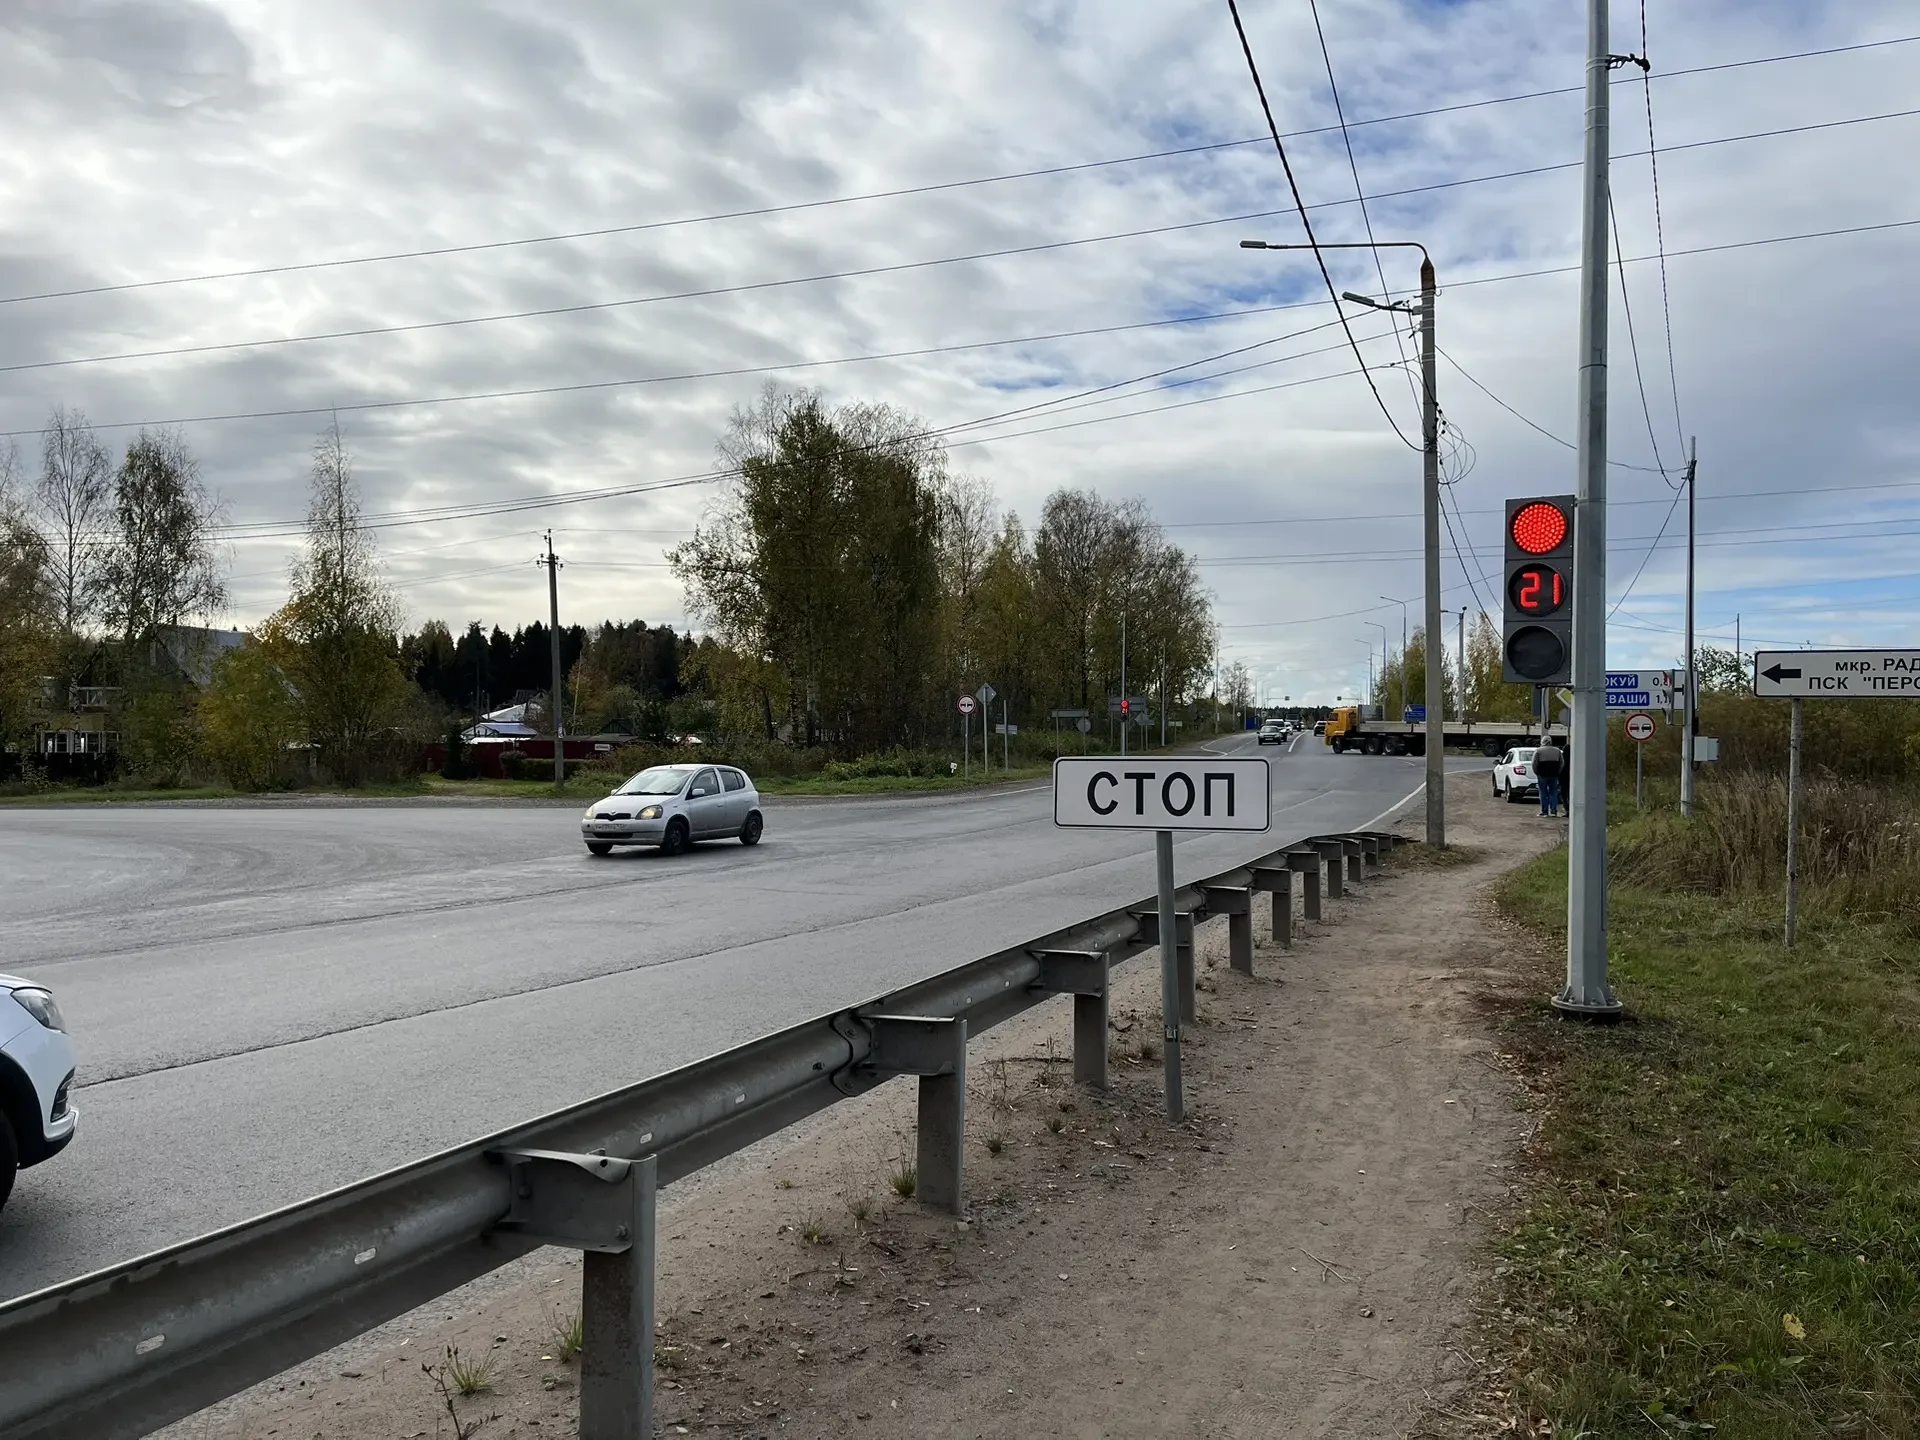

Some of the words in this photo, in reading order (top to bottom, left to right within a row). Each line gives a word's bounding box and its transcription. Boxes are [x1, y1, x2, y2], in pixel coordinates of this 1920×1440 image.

[1520, 572, 1560, 608] 21
[1836, 661, 1876, 674] мкр.
[1883, 657, 1920, 673] РАД
[1808, 676, 1849, 689] ПСК
[1087, 771, 1235, 817] СТОП
